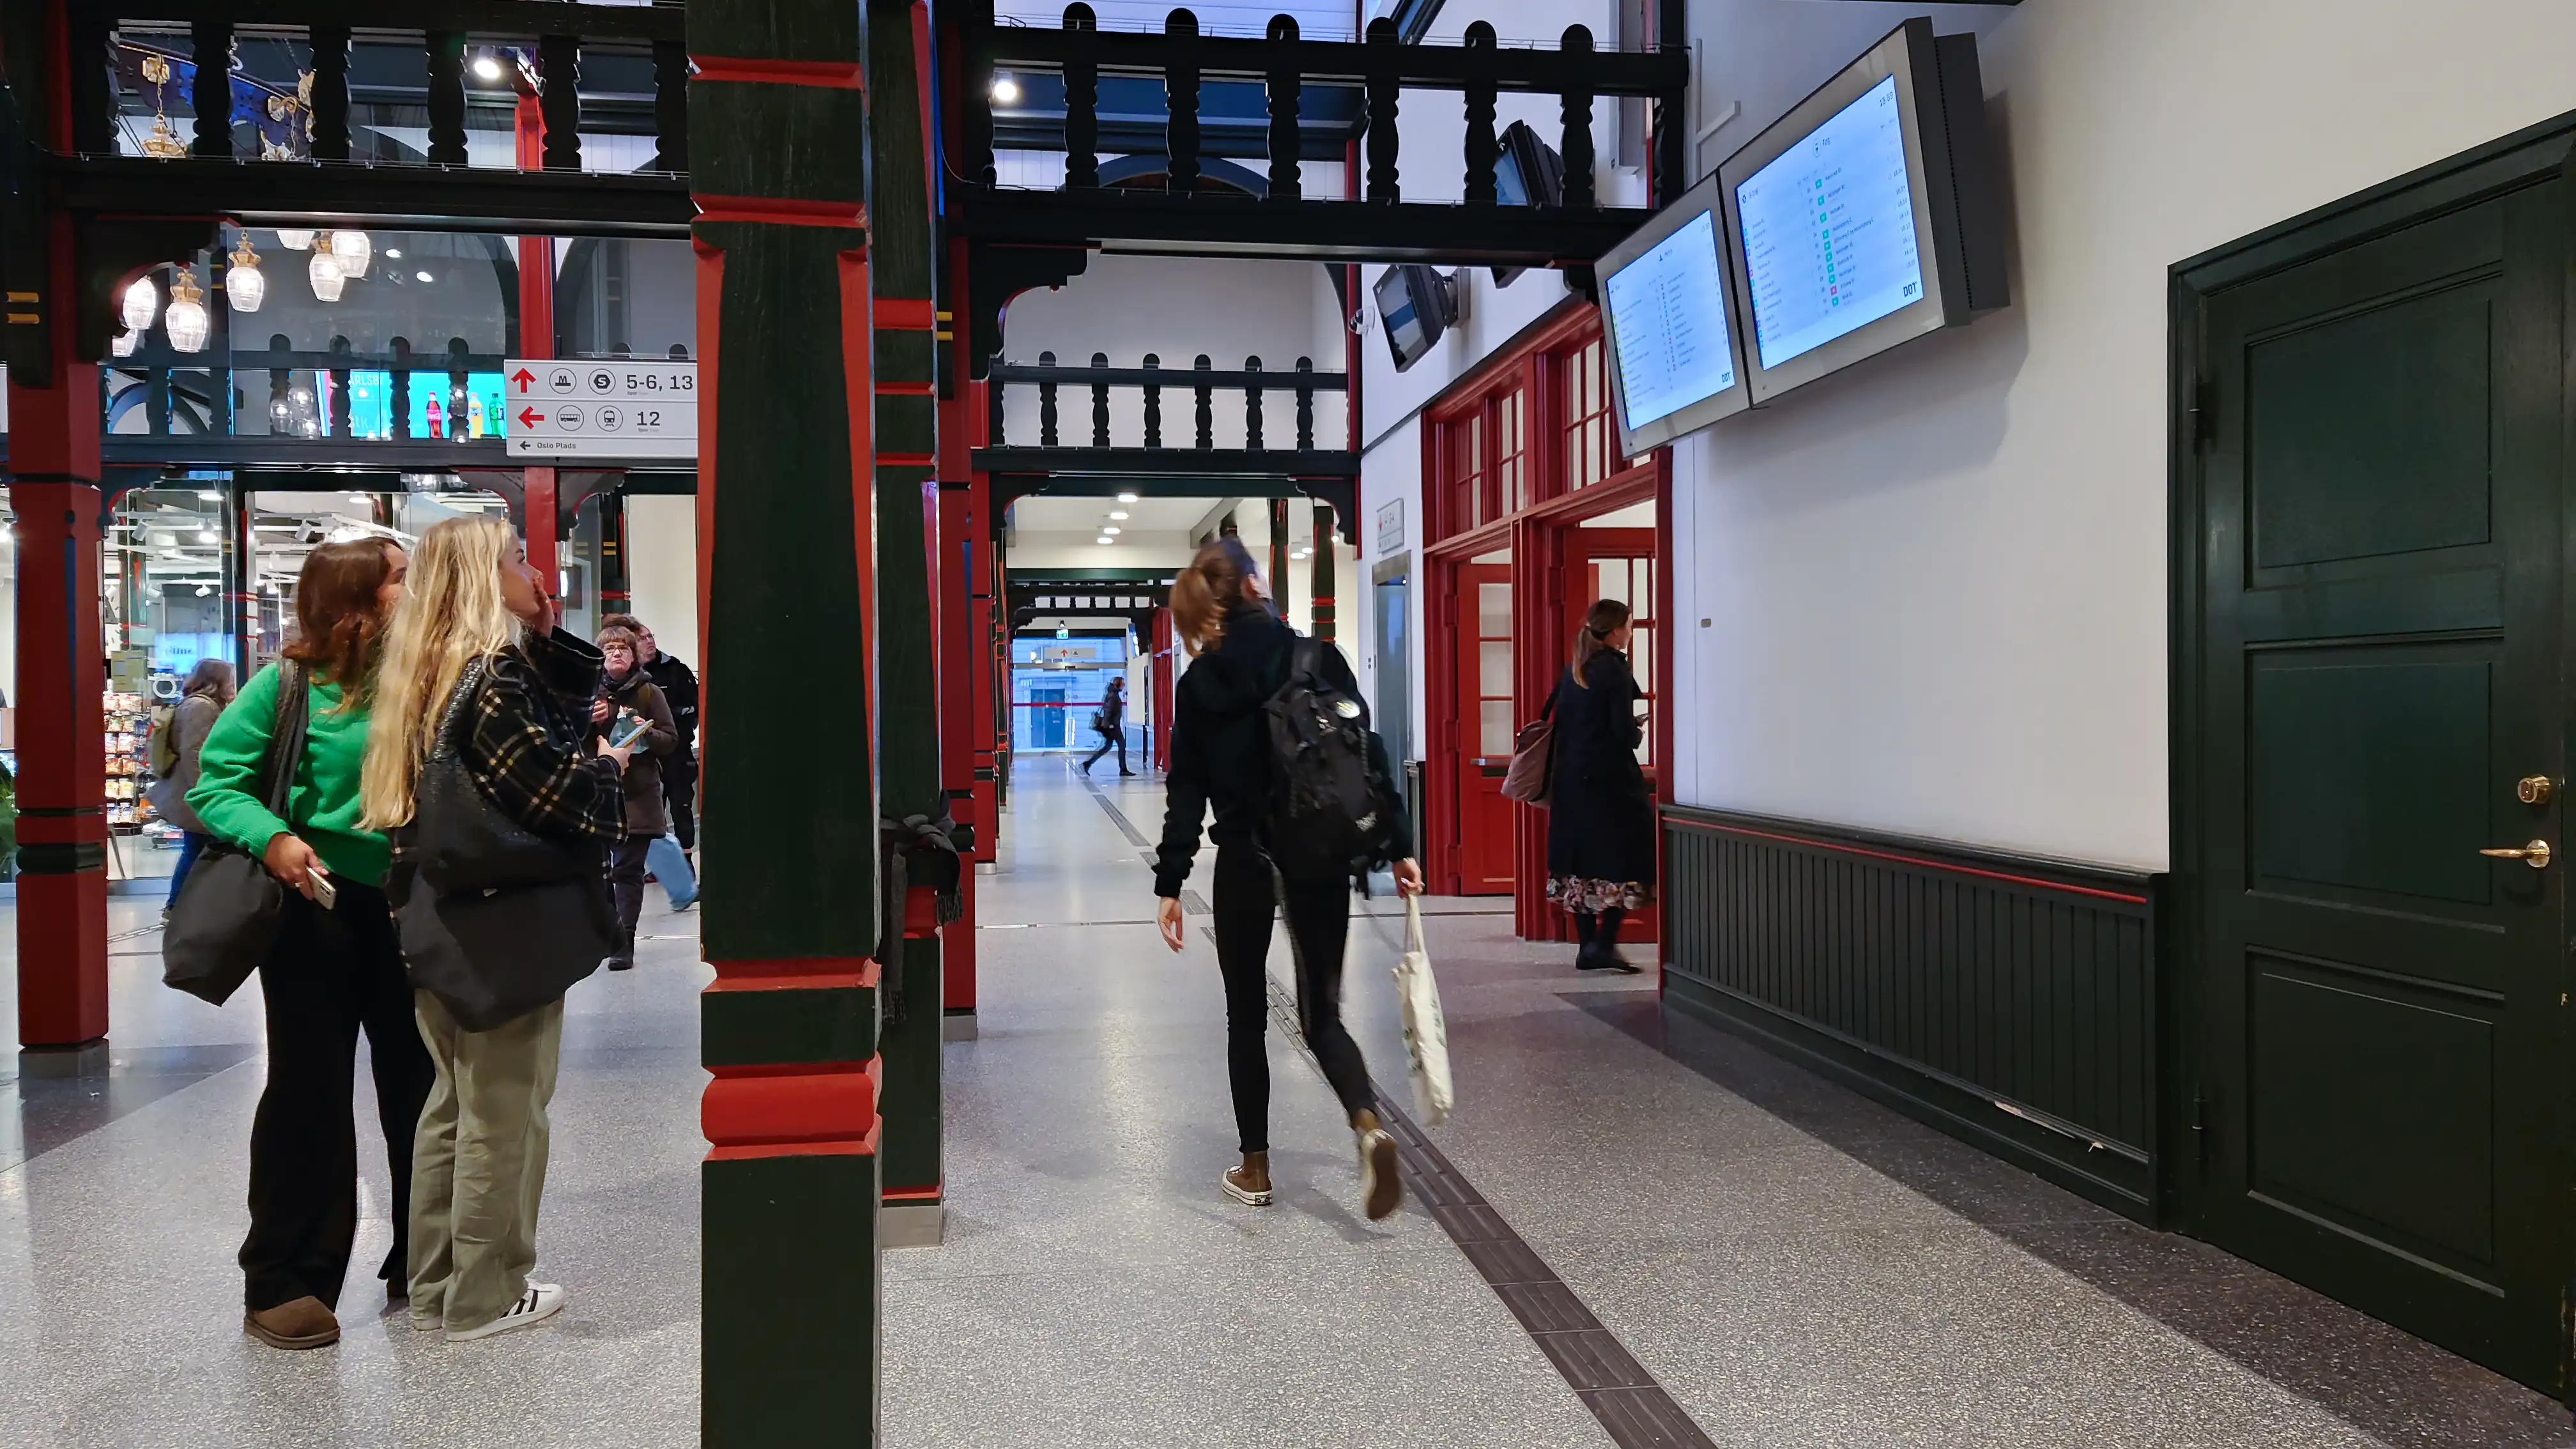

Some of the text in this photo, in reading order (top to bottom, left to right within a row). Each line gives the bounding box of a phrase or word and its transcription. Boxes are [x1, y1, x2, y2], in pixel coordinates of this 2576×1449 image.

[1903, 281, 1917, 298] DOT
[626, 374, 663, 392] 5-6,
[670, 375, 694, 390] 13
[636, 411, 661, 426] 12
